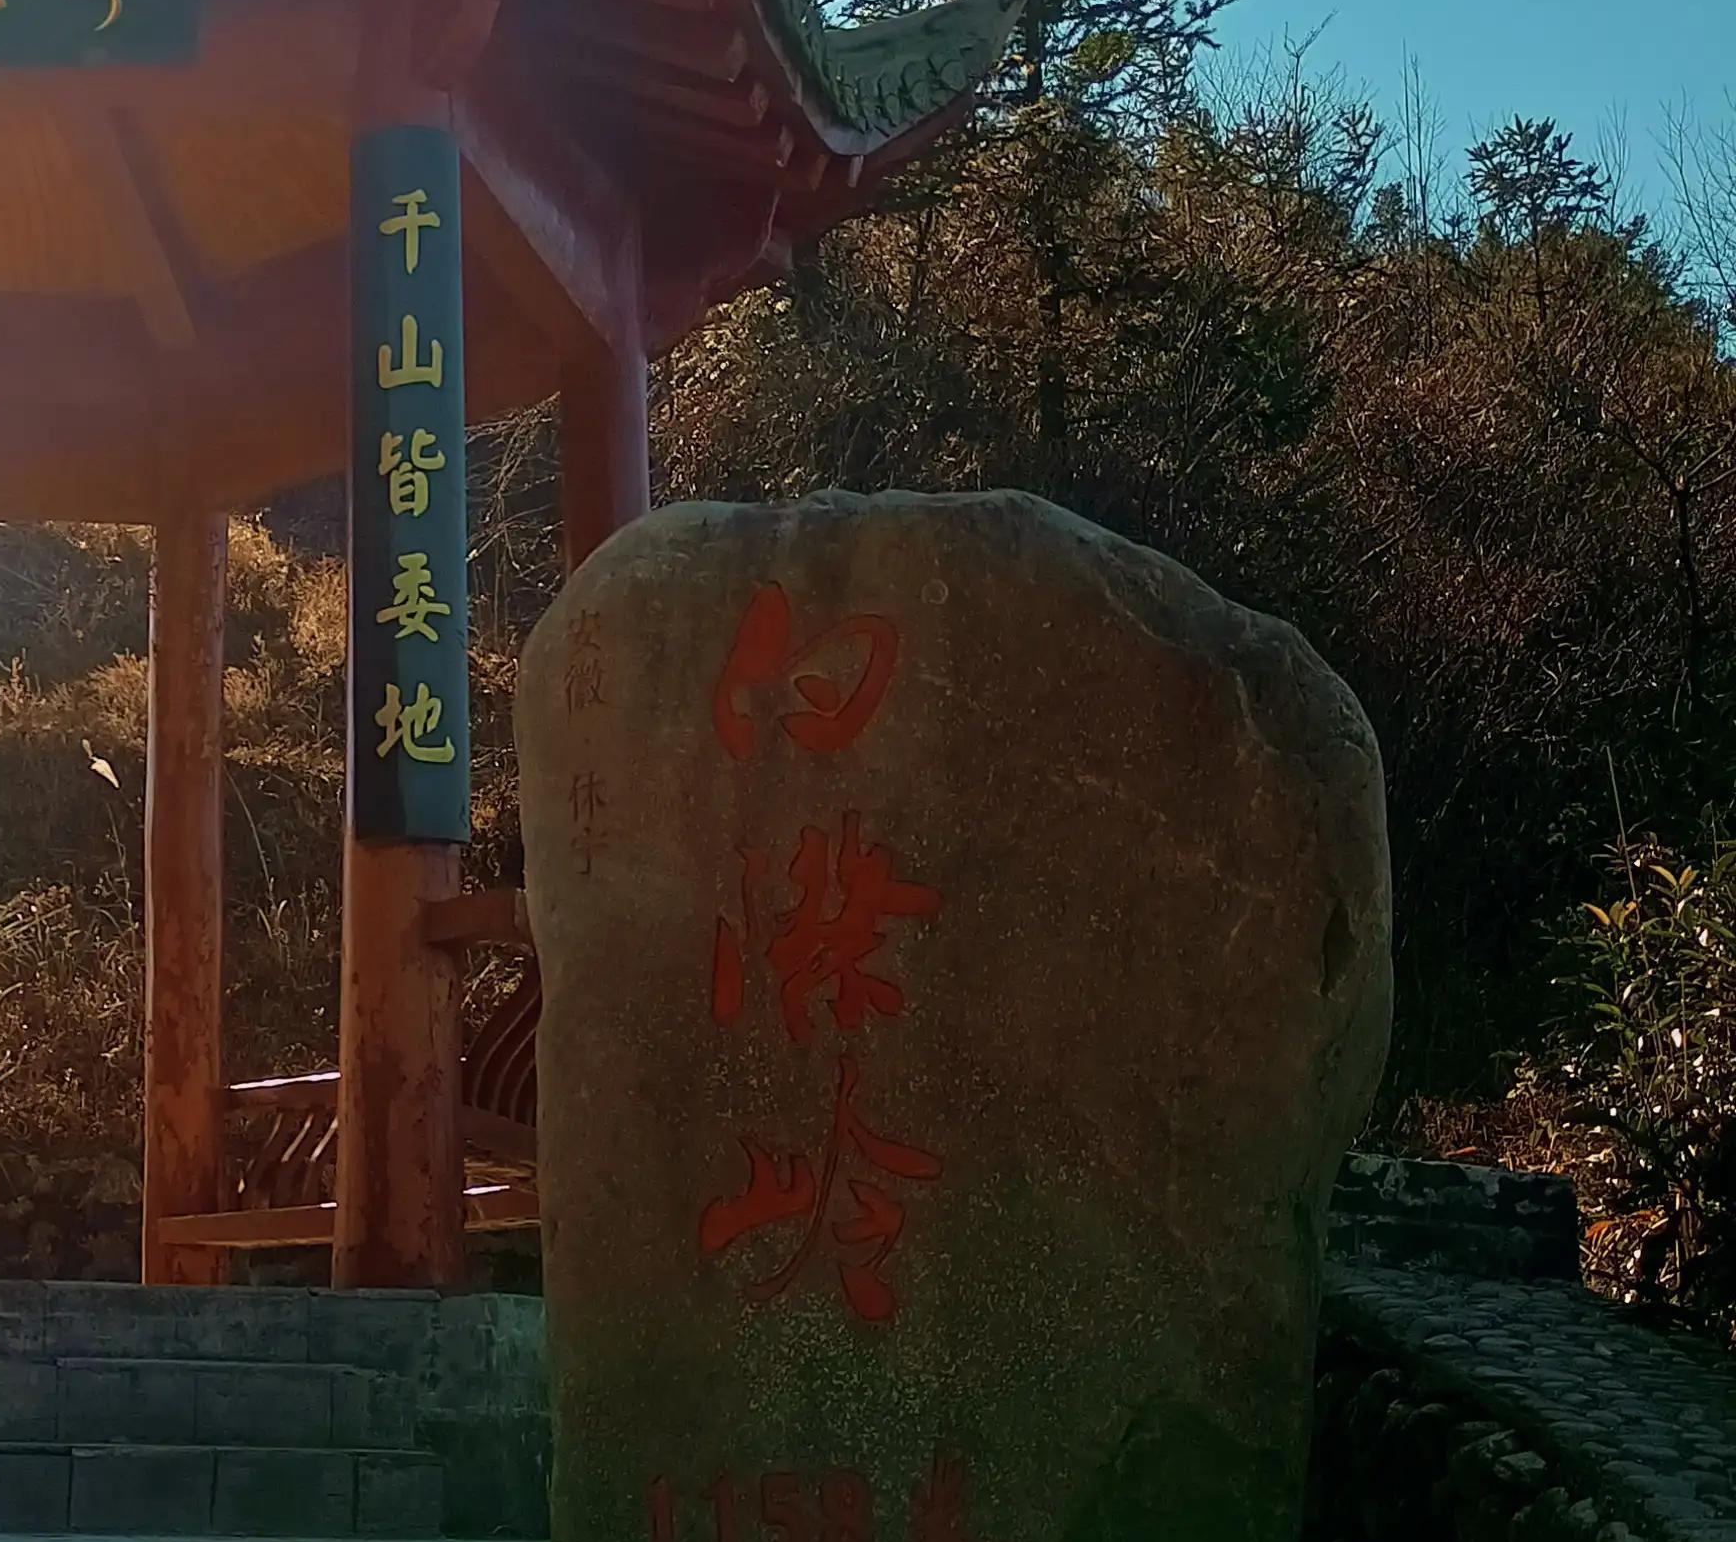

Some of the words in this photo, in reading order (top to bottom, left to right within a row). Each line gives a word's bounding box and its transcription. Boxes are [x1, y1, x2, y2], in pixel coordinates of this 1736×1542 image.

[374, 188, 456, 765] 千山皆委地
